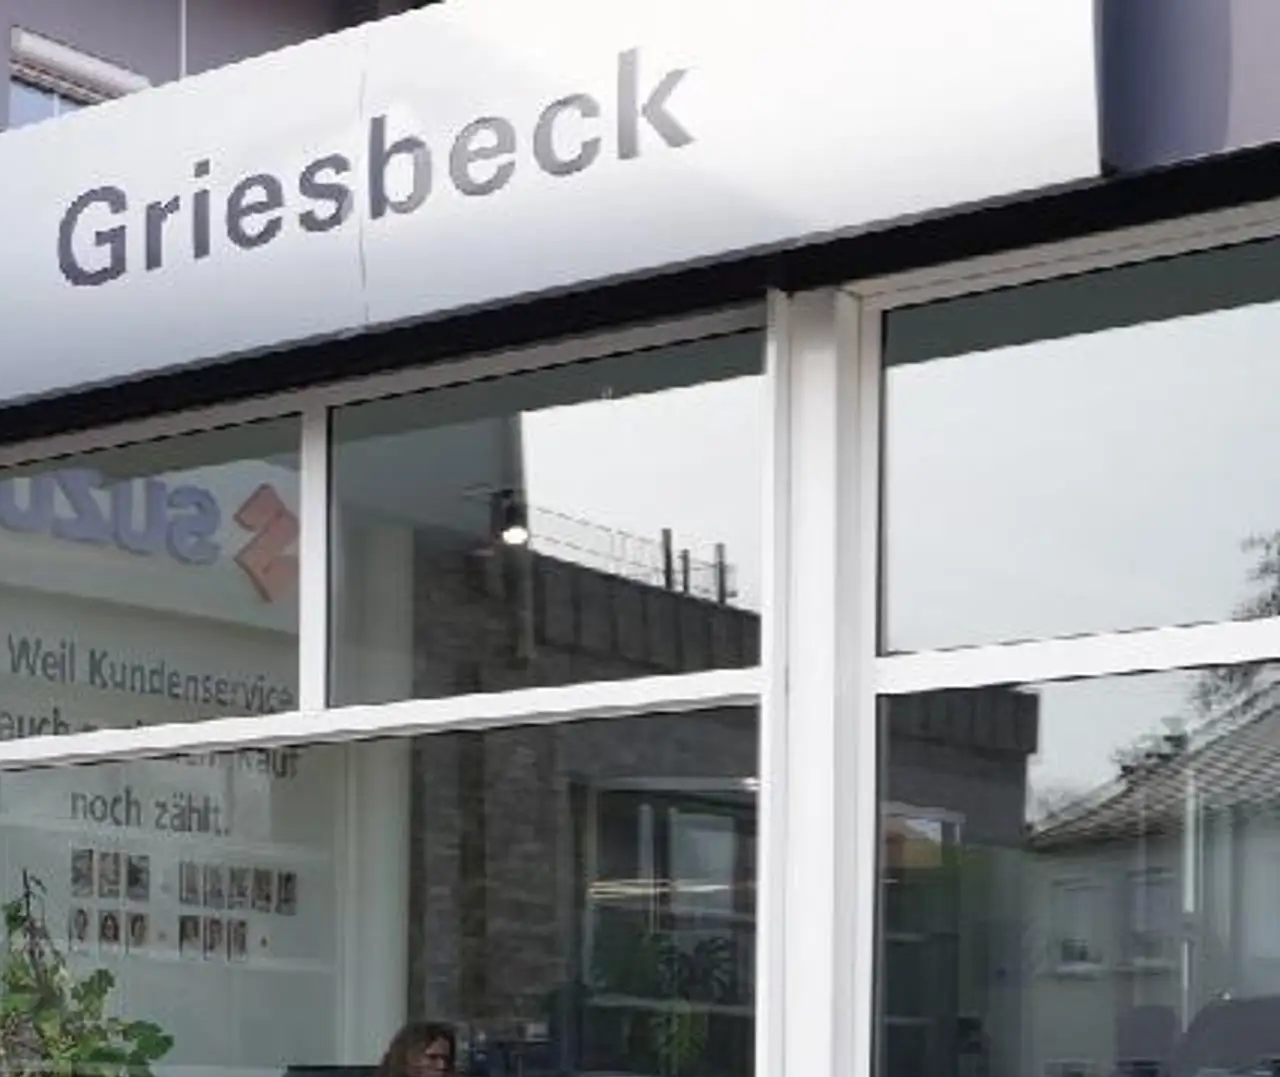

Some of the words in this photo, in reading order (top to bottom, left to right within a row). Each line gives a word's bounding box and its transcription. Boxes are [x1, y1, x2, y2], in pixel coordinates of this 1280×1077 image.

[57, 46, 696, 287] Griesbeck
[7, 632, 76, 686] Weil
[70, 786, 141, 828] noch
[154, 793, 232, 837] zählt.
